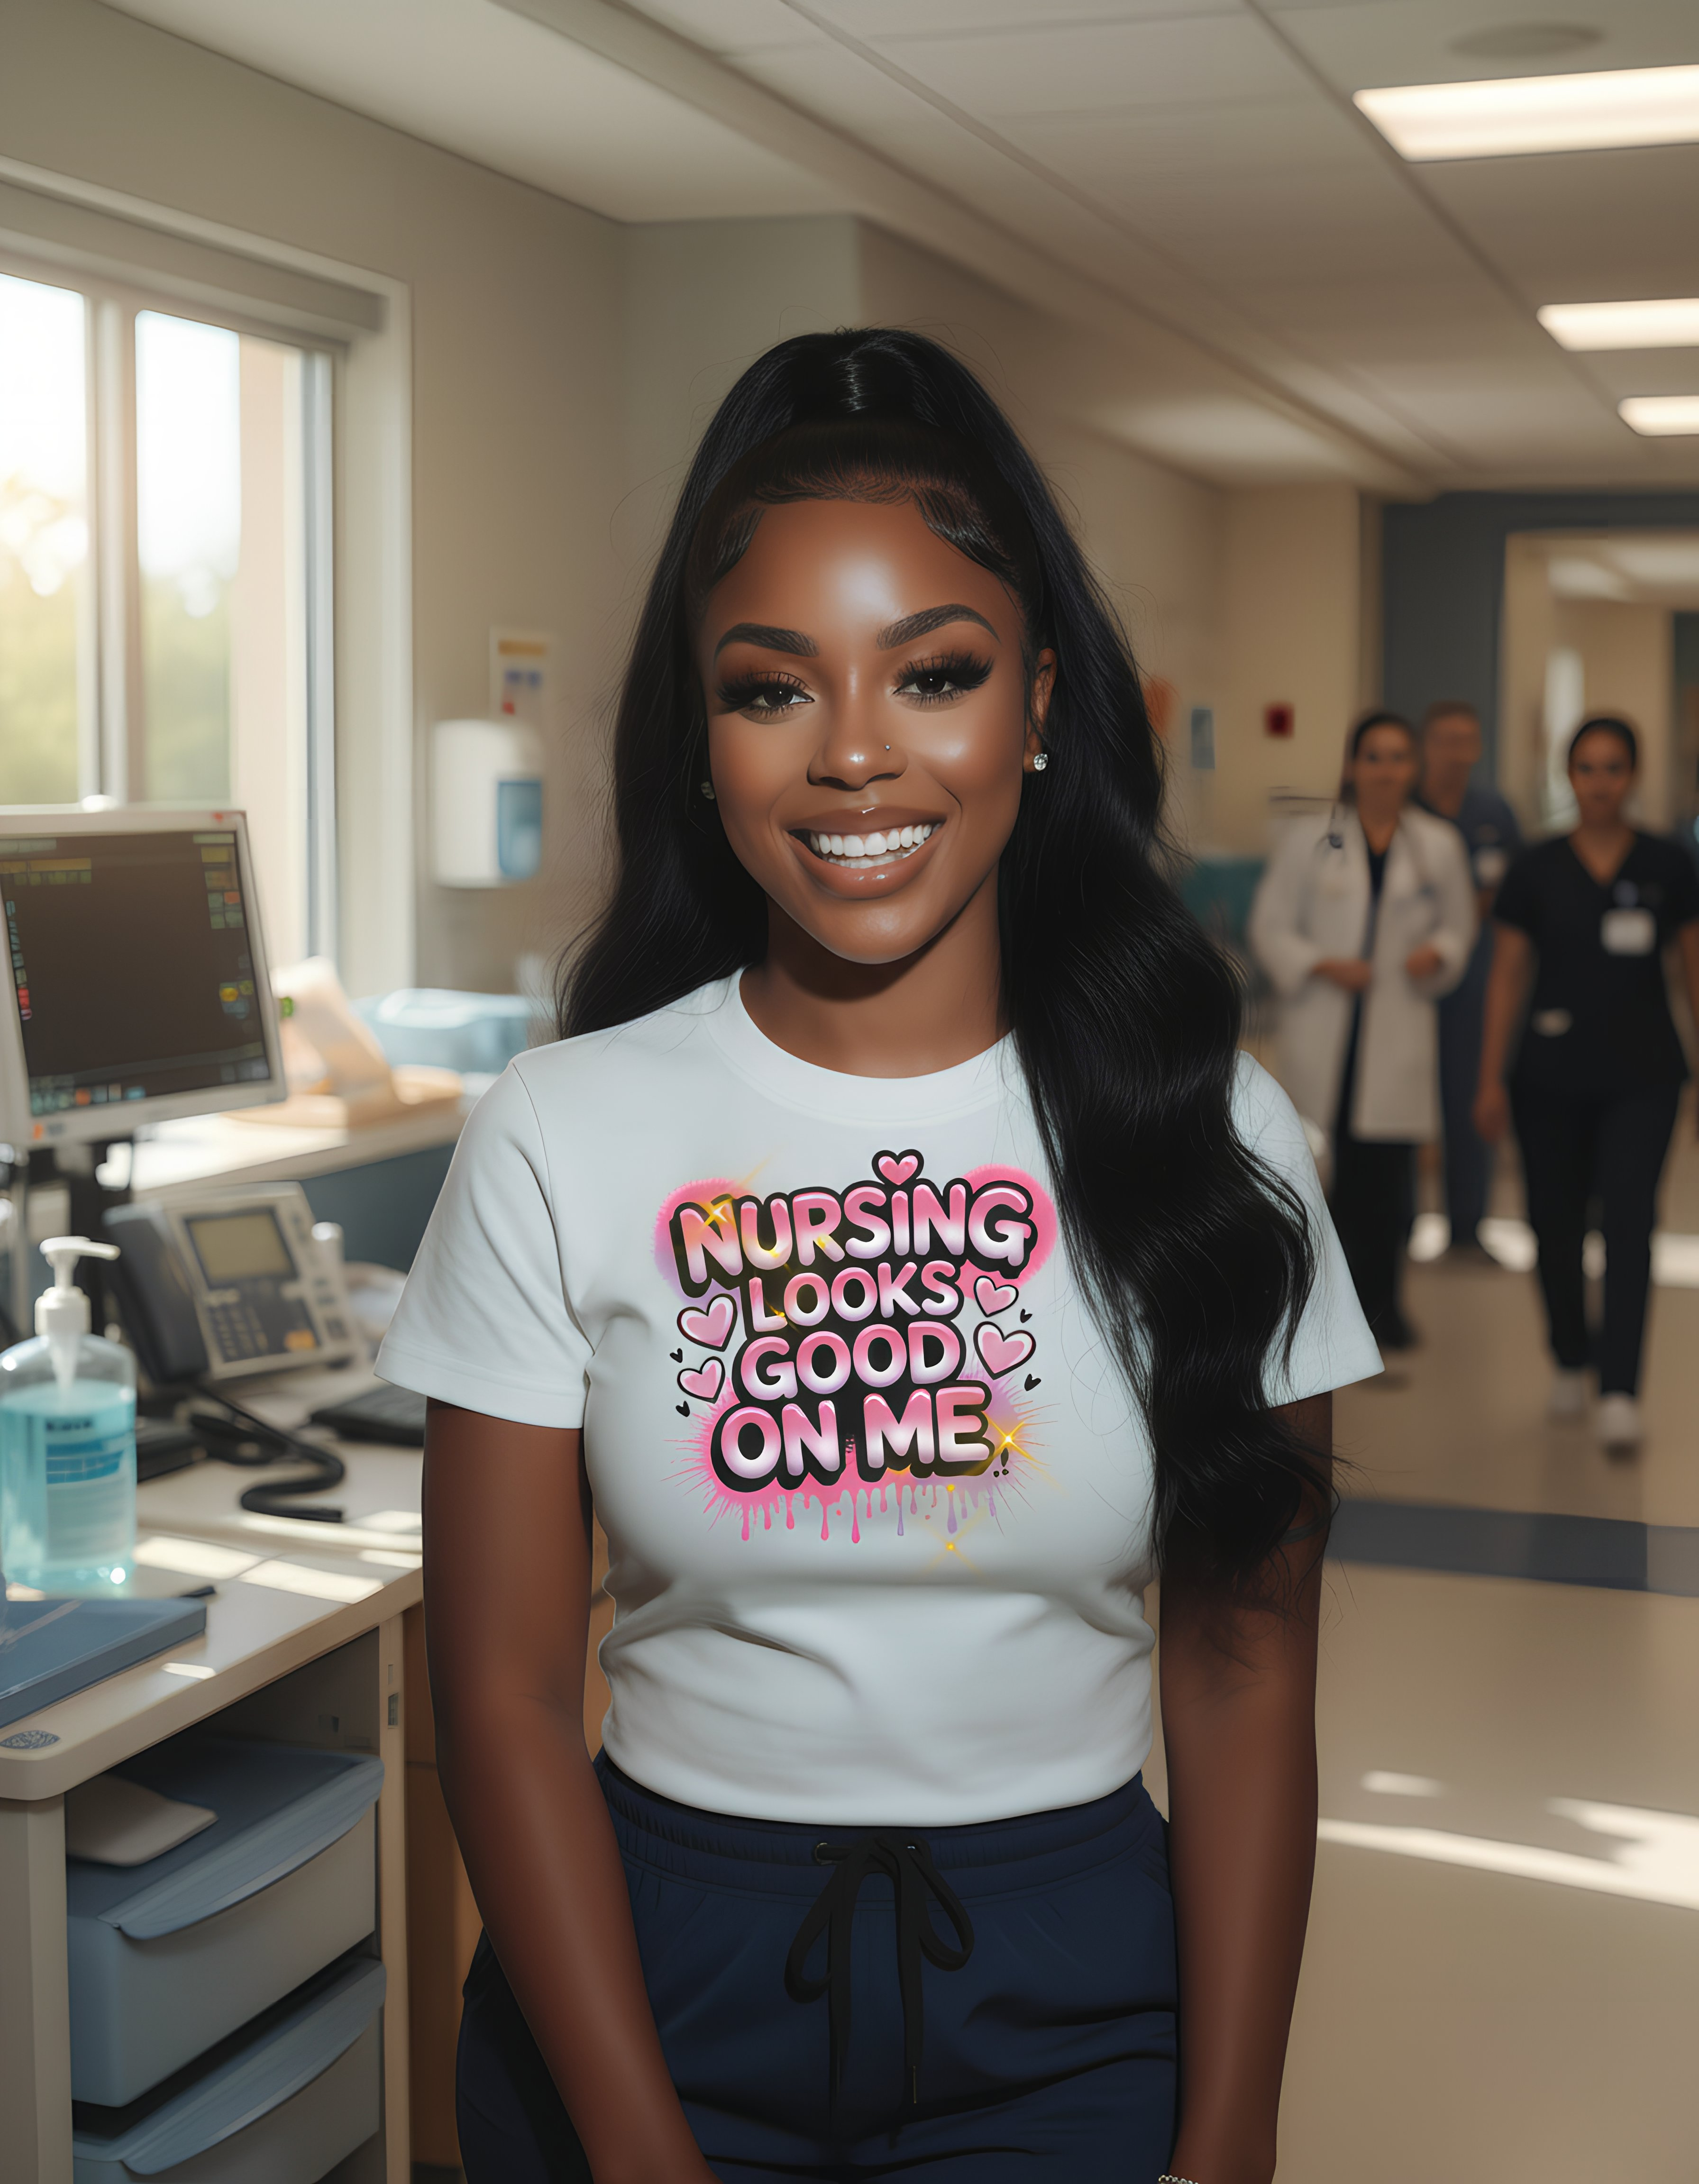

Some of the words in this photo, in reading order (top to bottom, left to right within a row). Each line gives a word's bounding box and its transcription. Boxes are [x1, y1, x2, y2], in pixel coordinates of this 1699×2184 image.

[678, 1183, 1032, 1284] NURSING
[749, 1259, 958, 1332] LOOKS
[740, 1320, 961, 1401] GOOD
[721, 1400, 840, 1479] ON
[863, 1388, 990, 1469] ME
